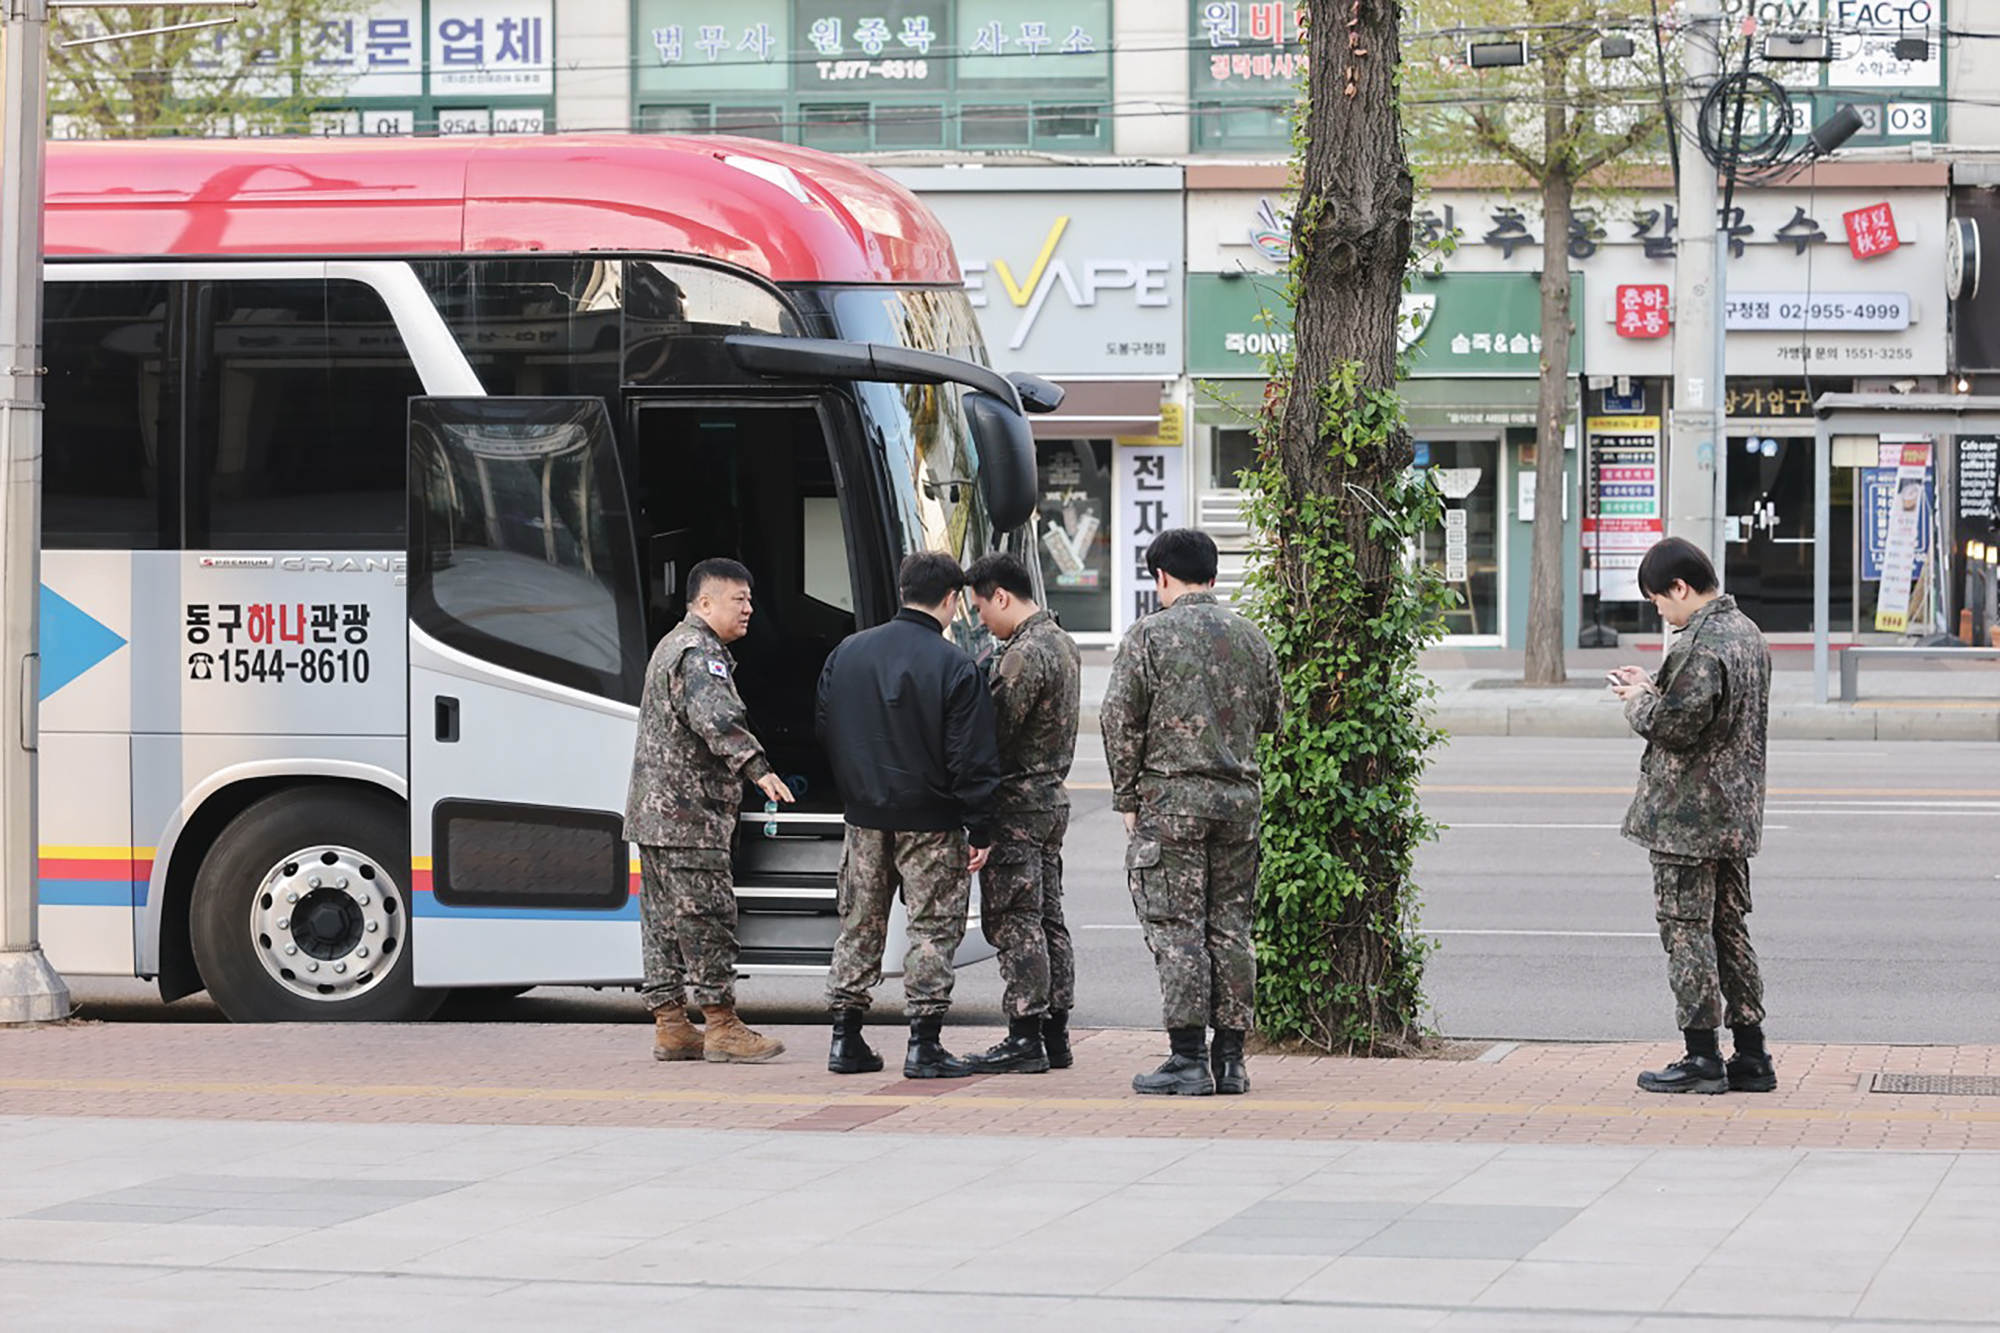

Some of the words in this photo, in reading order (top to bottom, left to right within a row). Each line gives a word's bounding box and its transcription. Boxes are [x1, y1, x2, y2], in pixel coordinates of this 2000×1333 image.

[1838, 0, 1931, 27] FACTO
[653, 25, 776, 61] 법무사
[970, 21, 1096, 55] 사무소
[1780, 304, 1900, 318] 02-955-4999
[1105, 342, 1166, 356] 도봉구청점
[1225, 333, 1296, 354] 죽이야
[1815, 347, 1838, 360] 문의
[186, 603, 370, 644] 동구하나관광
[219, 648, 369, 683] 1544-8610
